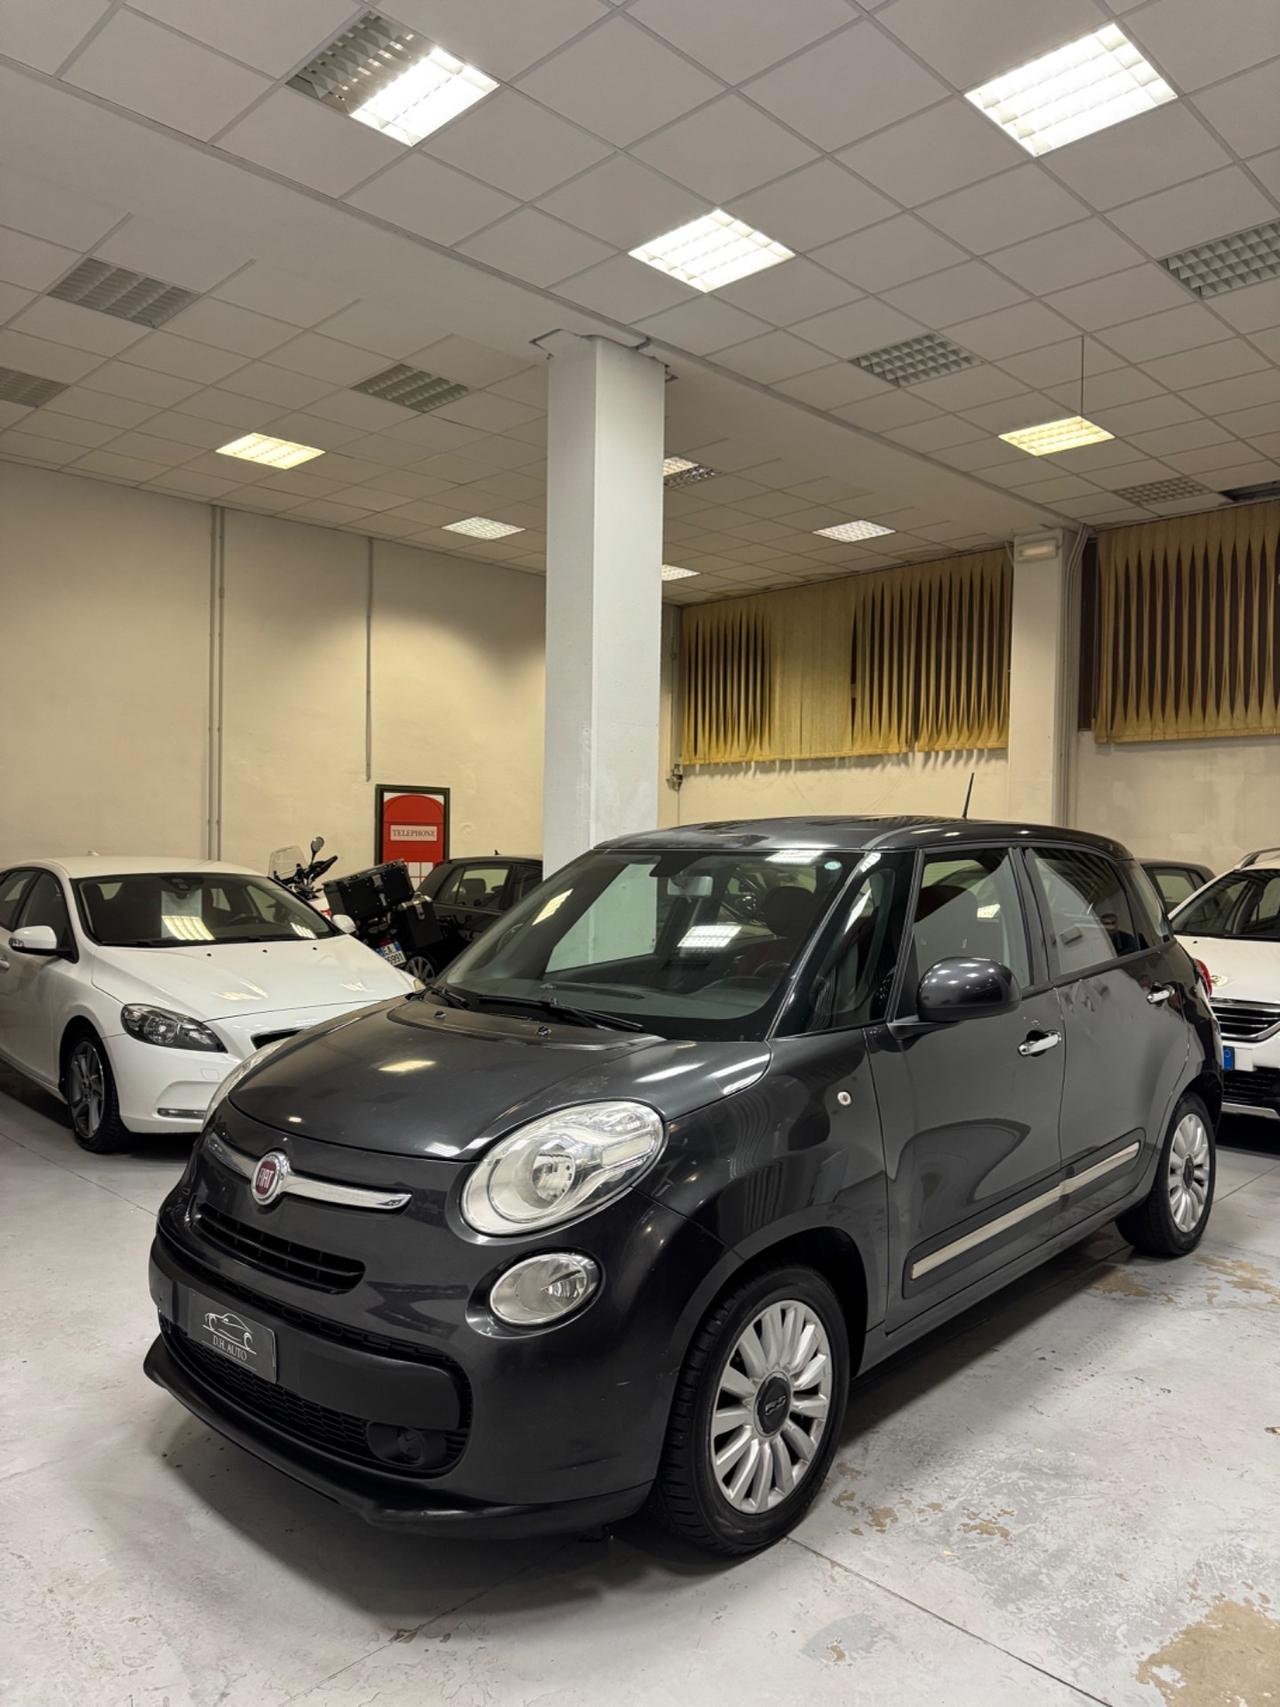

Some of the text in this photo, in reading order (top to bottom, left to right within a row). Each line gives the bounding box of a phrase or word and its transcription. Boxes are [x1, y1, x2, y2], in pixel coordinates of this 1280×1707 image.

[392, 829, 435, 838] TELEPHONE
[257, 1167, 275, 1189] FIAT
[227, 1343, 247, 1361] AUTO
